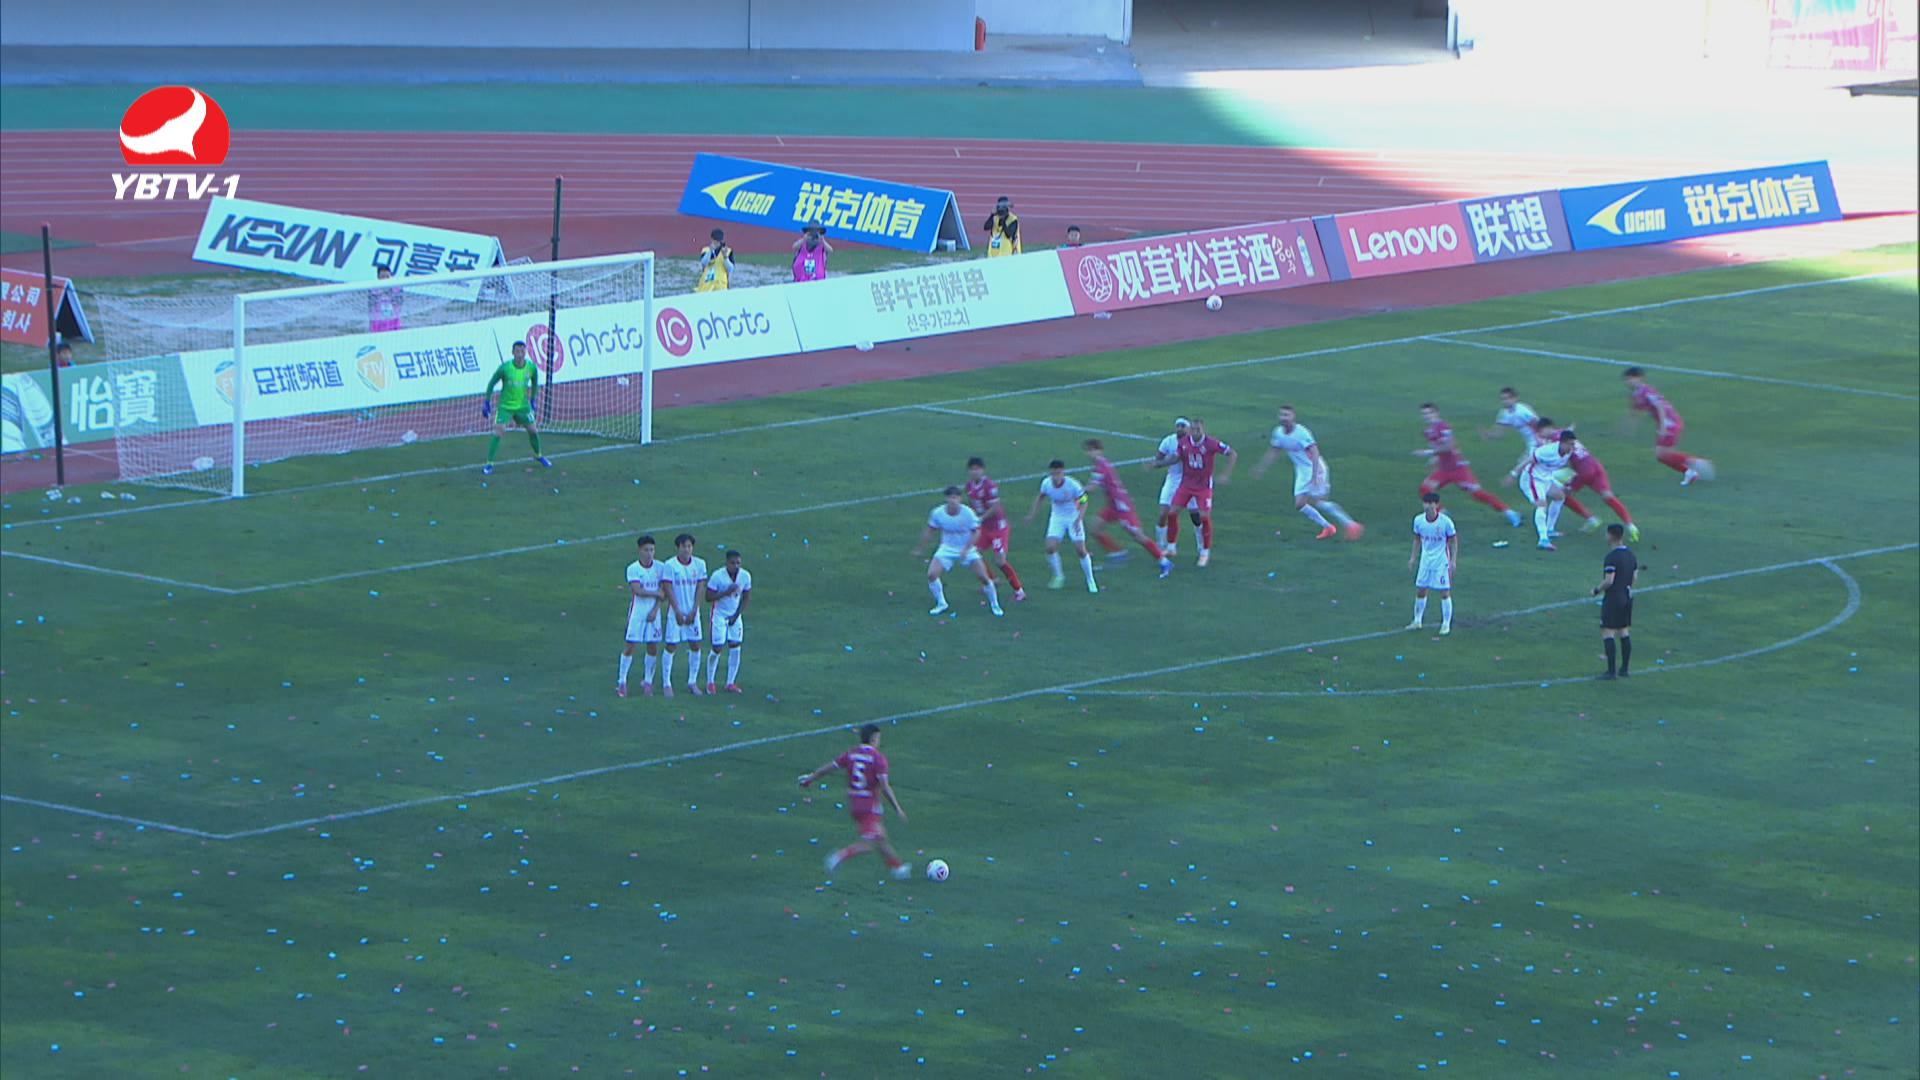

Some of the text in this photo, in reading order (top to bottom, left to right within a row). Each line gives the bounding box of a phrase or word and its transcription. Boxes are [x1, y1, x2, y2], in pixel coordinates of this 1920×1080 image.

[792, 181, 926, 240] 锐克体育
[1682, 174, 1821, 227] 锐克体育
[208, 213, 362, 269] KEXIAN
[1349, 223, 1458, 263] Lenovo
[1465, 195, 1553, 257] 联想
[1107, 232, 1281, 301] 观茸松茸酒
[568, 322, 643, 367] photo
[659, 307, 770, 350] IC photo
[252, 359, 345, 396] 足球频道
[393, 344, 481, 381] 足球频道
[70, 369, 160, 432] 怡寶
[851, 762, 867, 789] 5
